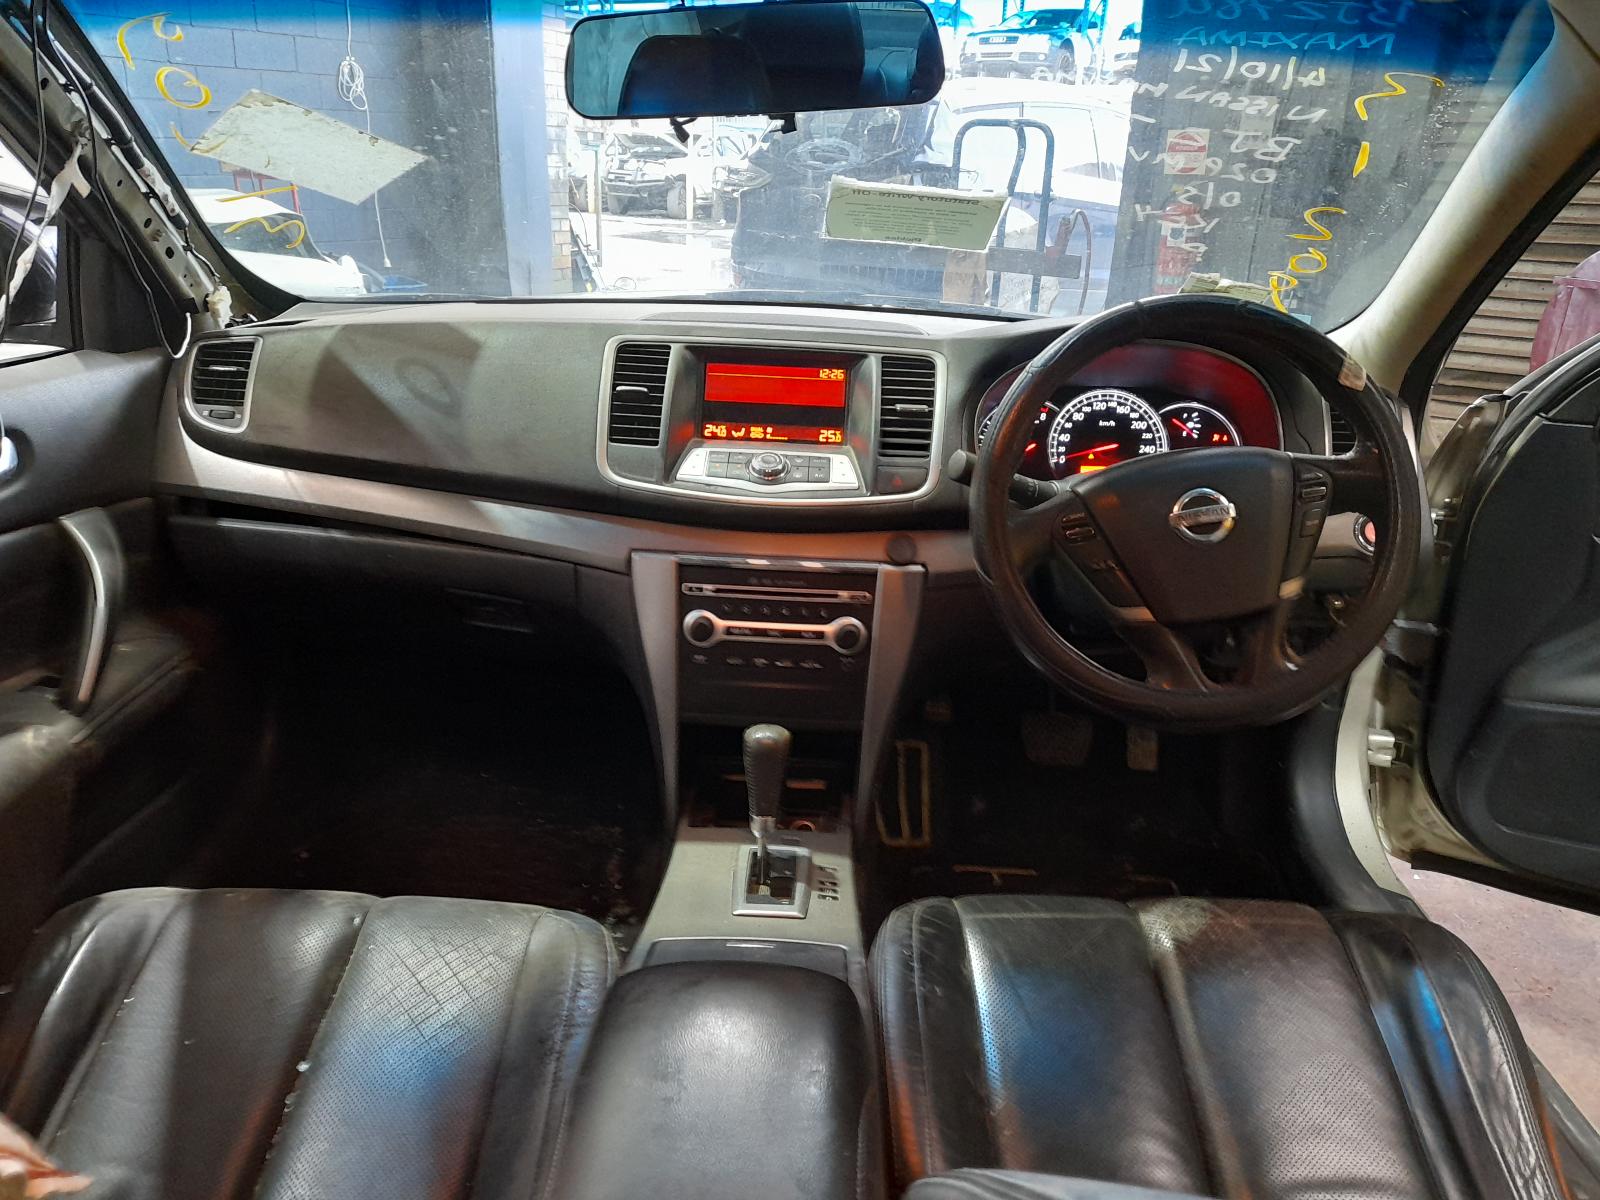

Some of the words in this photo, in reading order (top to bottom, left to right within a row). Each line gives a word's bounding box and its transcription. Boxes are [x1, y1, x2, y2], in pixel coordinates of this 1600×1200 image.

[819, 369, 844, 379] 12:26
[1092, 402, 1107, 410] 120
[1116, 406, 1131, 414] 160
[1039, 412, 1047, 421] 8
[1072, 412, 1084, 421] 80
[1130, 421, 1147, 430] 200
[1058, 434, 1070, 442] 40
[1138, 445, 1156, 453] 240
